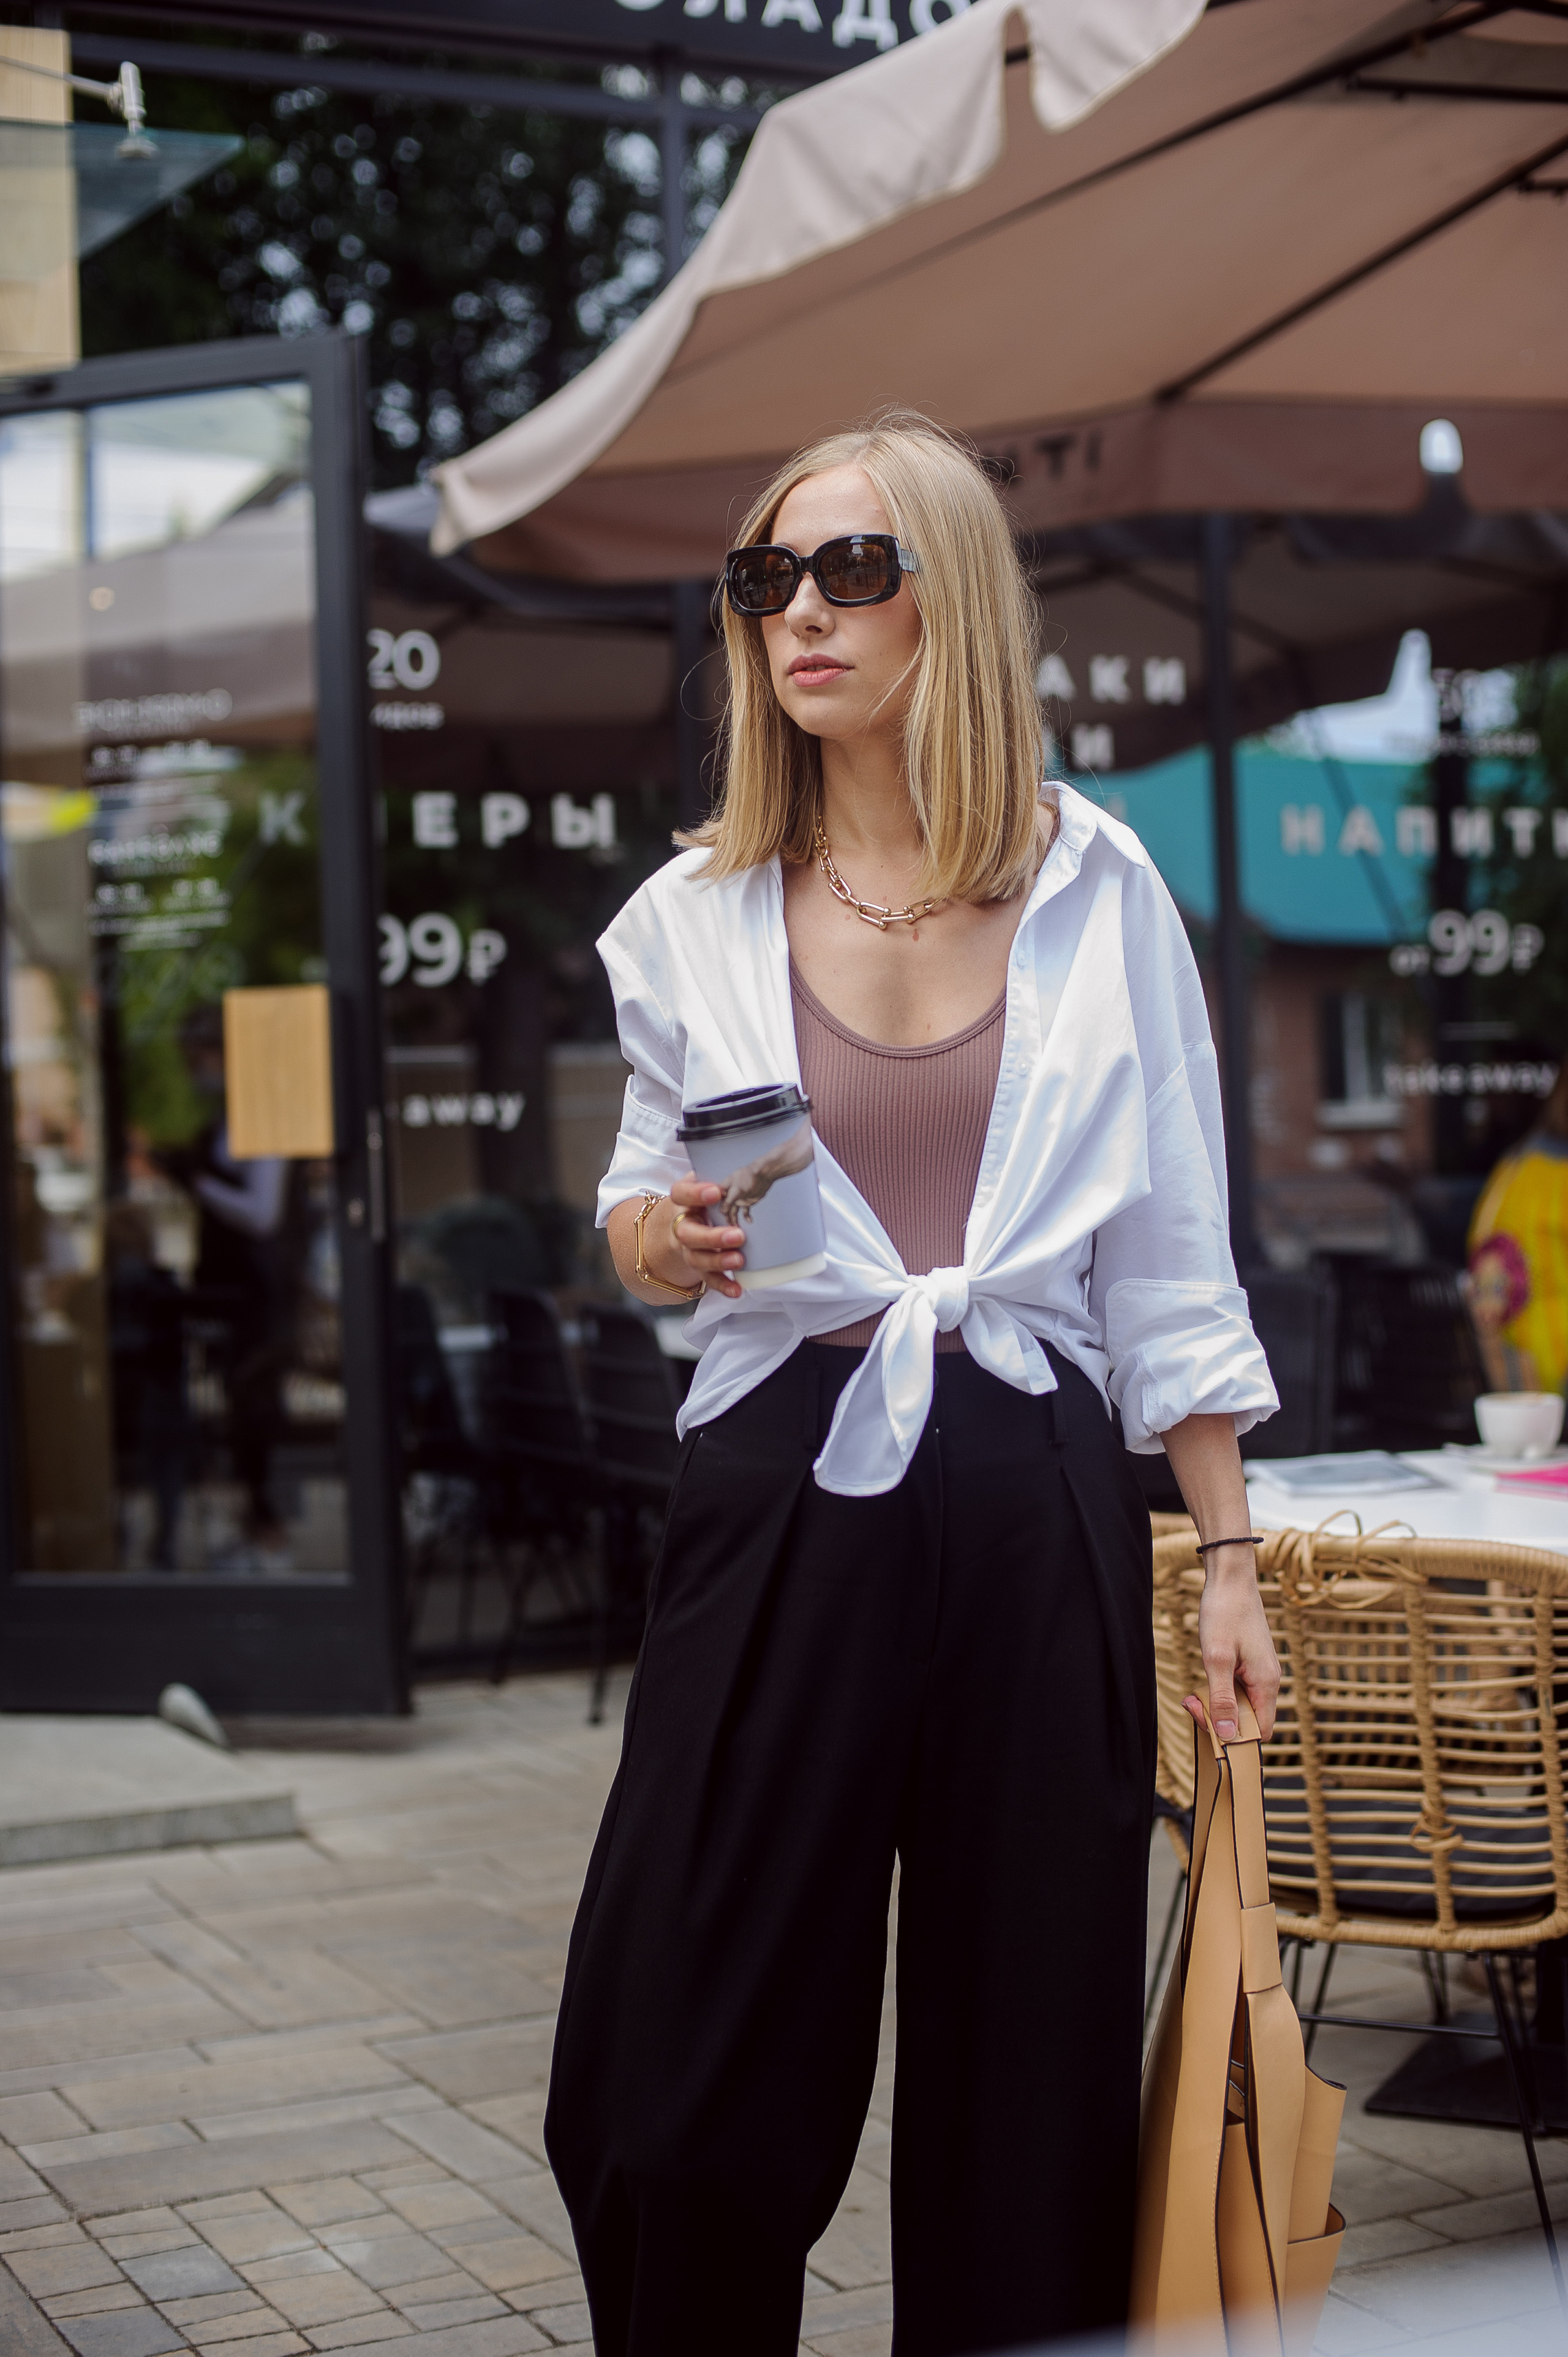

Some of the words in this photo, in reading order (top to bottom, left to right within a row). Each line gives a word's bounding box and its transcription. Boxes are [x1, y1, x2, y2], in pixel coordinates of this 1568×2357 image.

[366, 627, 440, 690] 20
[1035, 653, 1186, 705] АКИ
[402, 1091, 526, 1132] away
